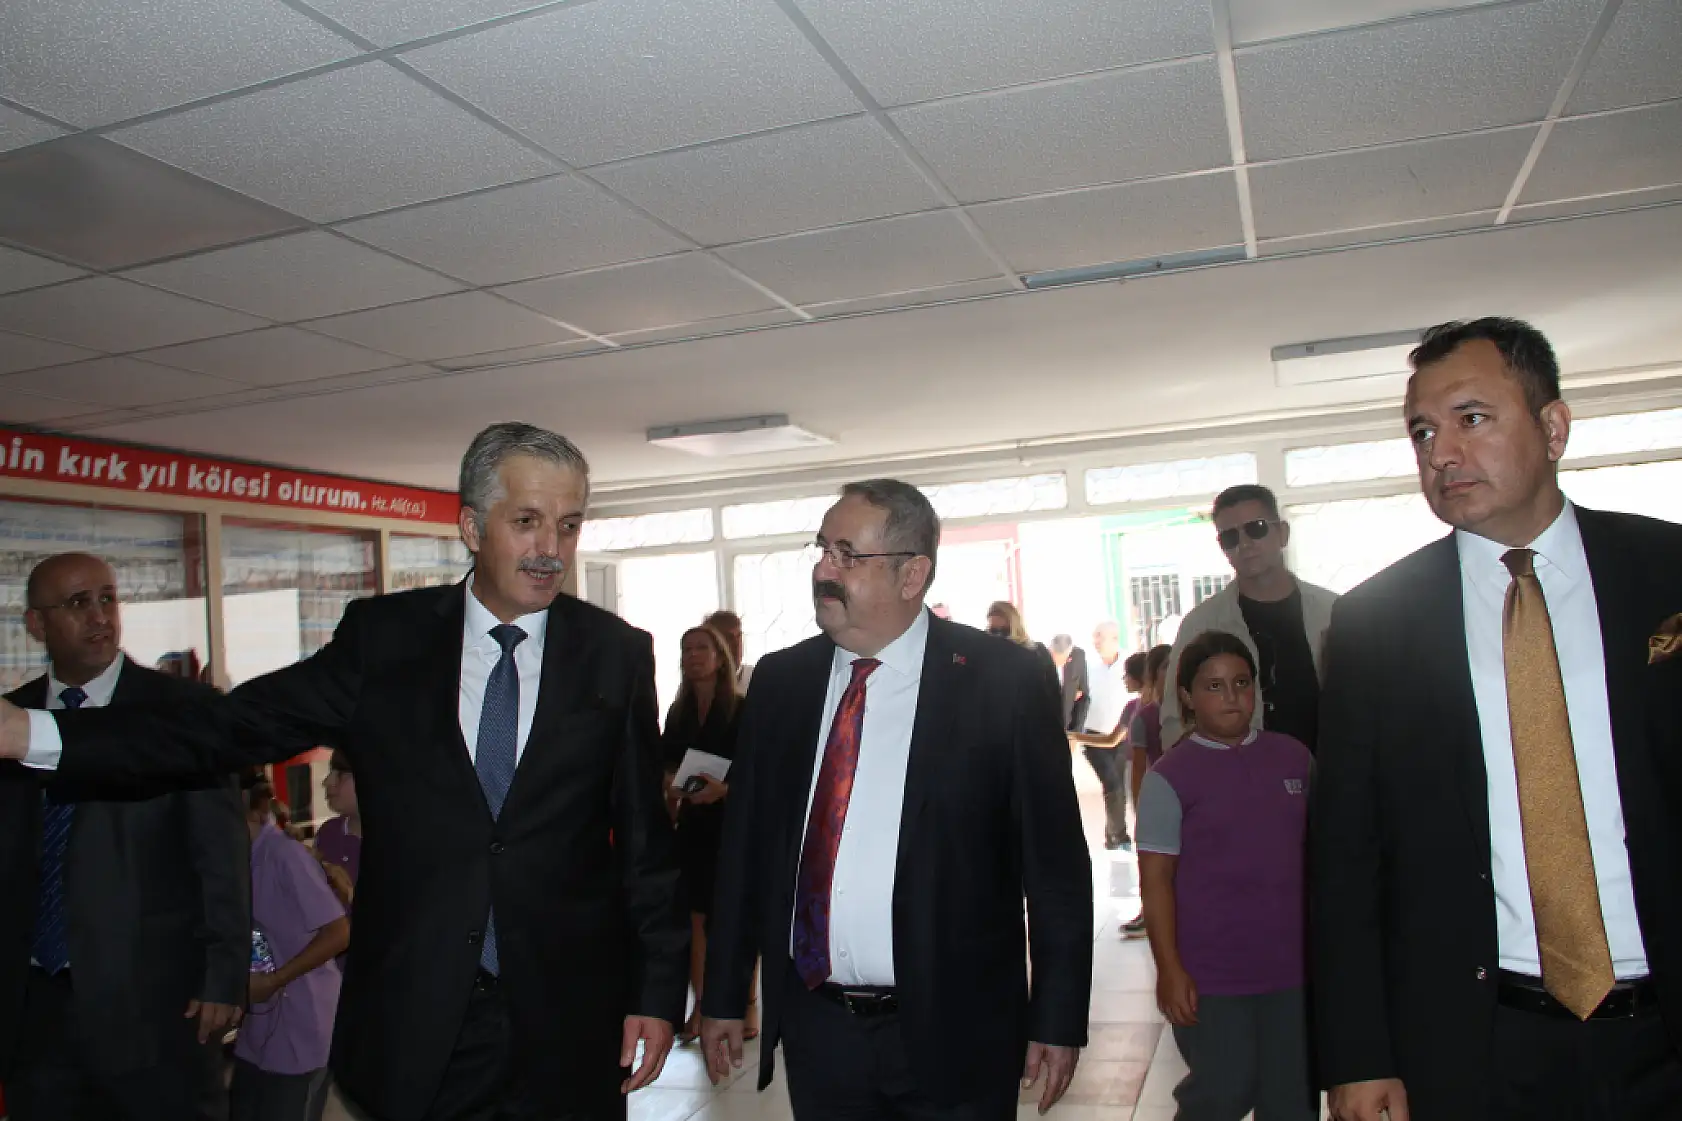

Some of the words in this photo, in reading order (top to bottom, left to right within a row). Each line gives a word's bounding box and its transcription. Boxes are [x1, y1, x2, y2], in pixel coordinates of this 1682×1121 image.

[0, 437, 44, 472] in
[58, 446, 129, 481] kırk
[137, 461, 178, 490] yıl
[186, 463, 271, 499] kölesi
[277, 479, 367, 511] olurum.
